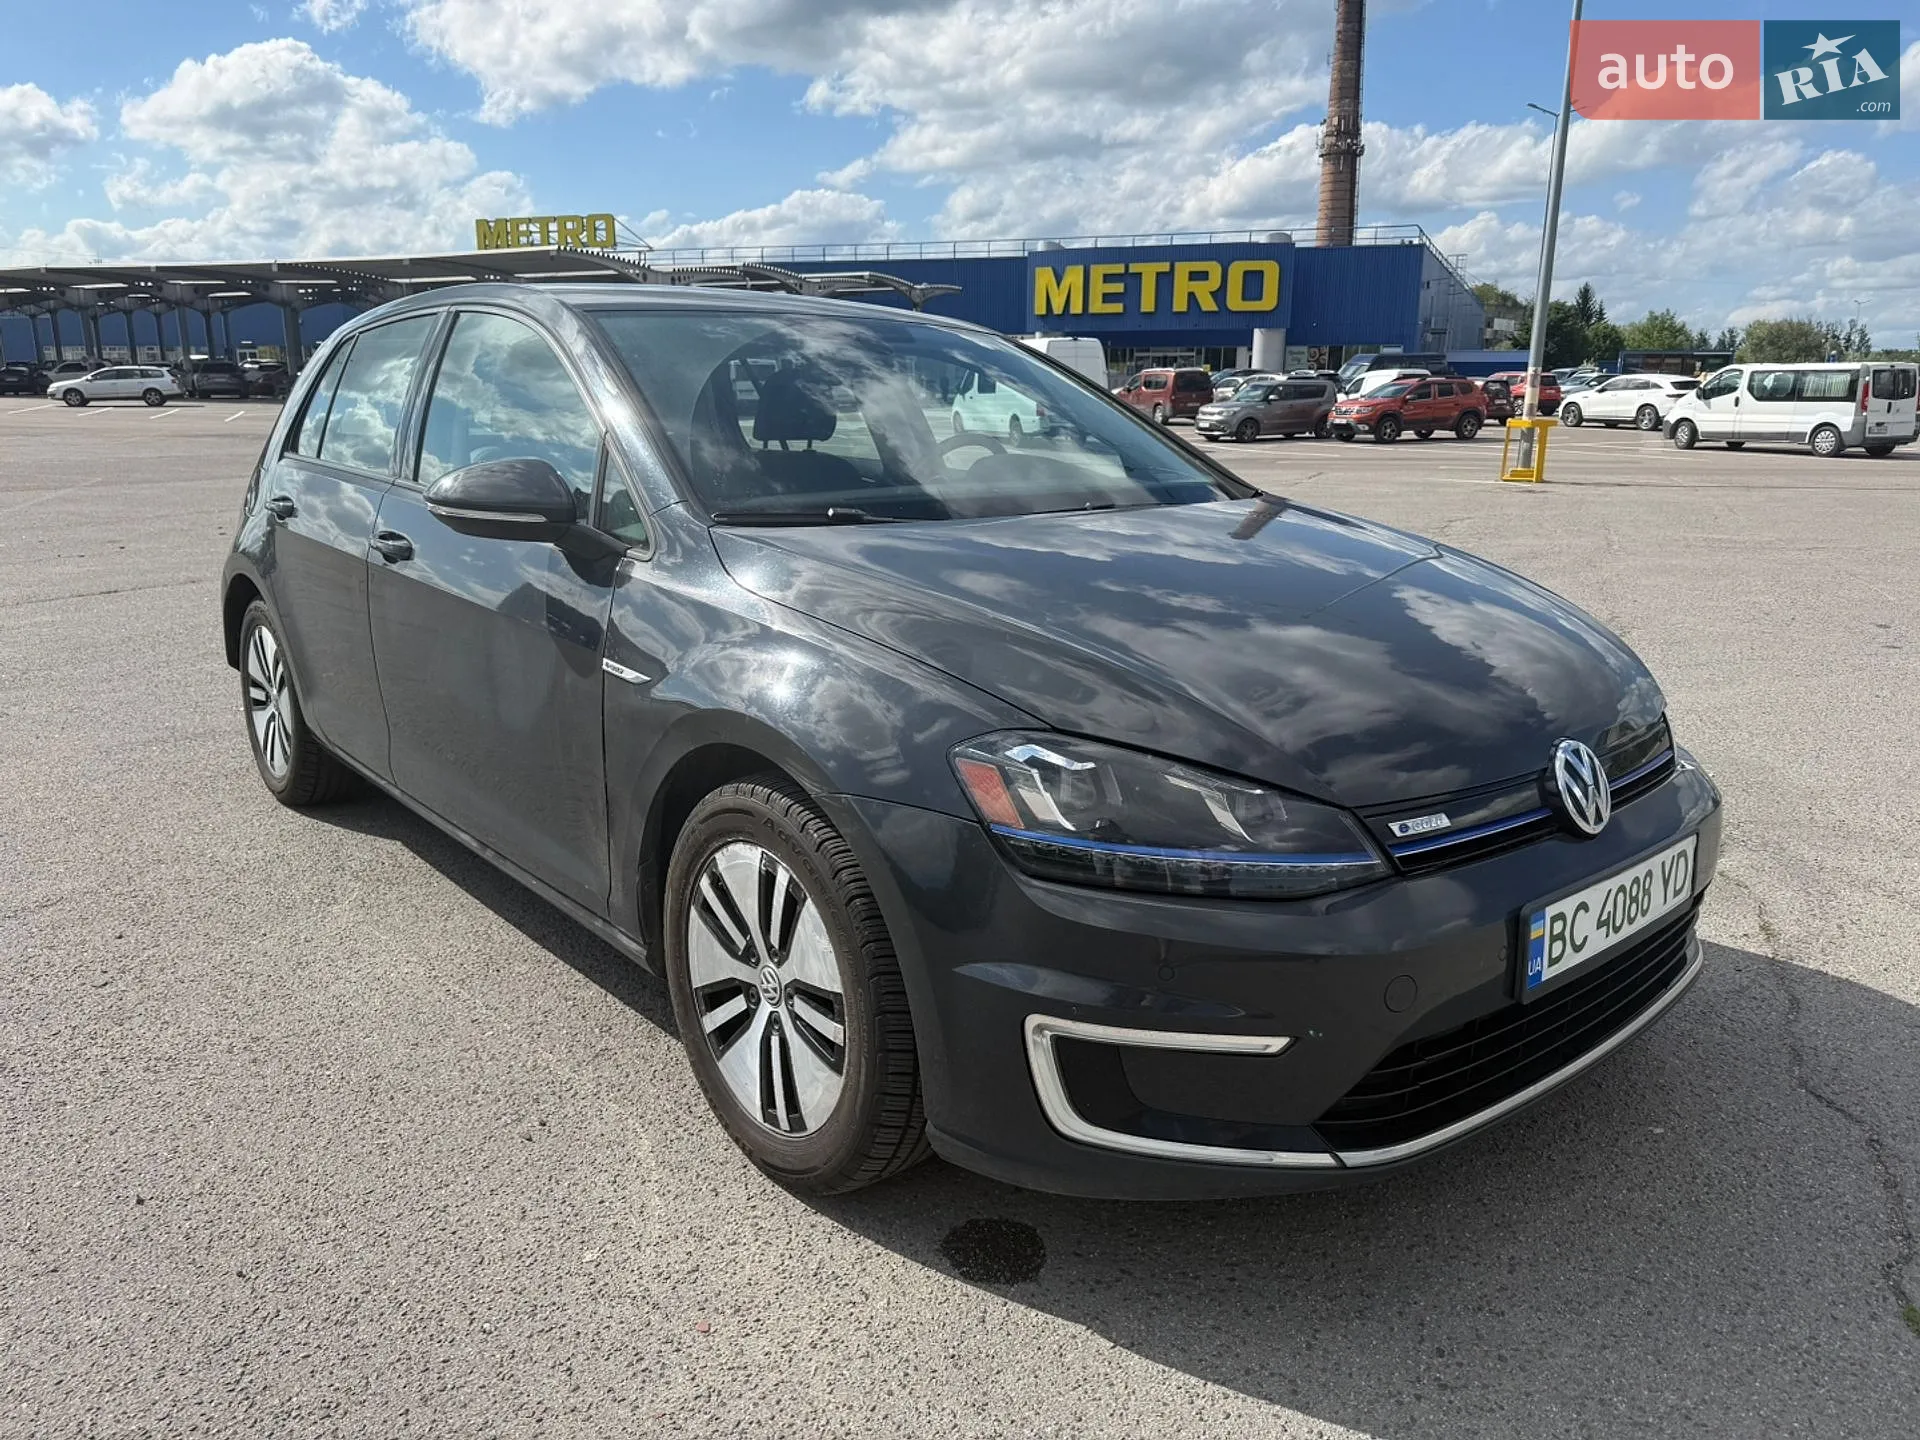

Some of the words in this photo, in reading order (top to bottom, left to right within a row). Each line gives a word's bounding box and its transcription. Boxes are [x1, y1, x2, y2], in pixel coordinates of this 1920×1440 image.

[476, 214, 616, 250] METRO
[1034, 260, 1280, 315] METRO
[1547, 901, 1589, 969] BC
[1596, 869, 1653, 938] 4088
[1661, 849, 1689, 904] YD
[1528, 957, 1542, 976] UA
